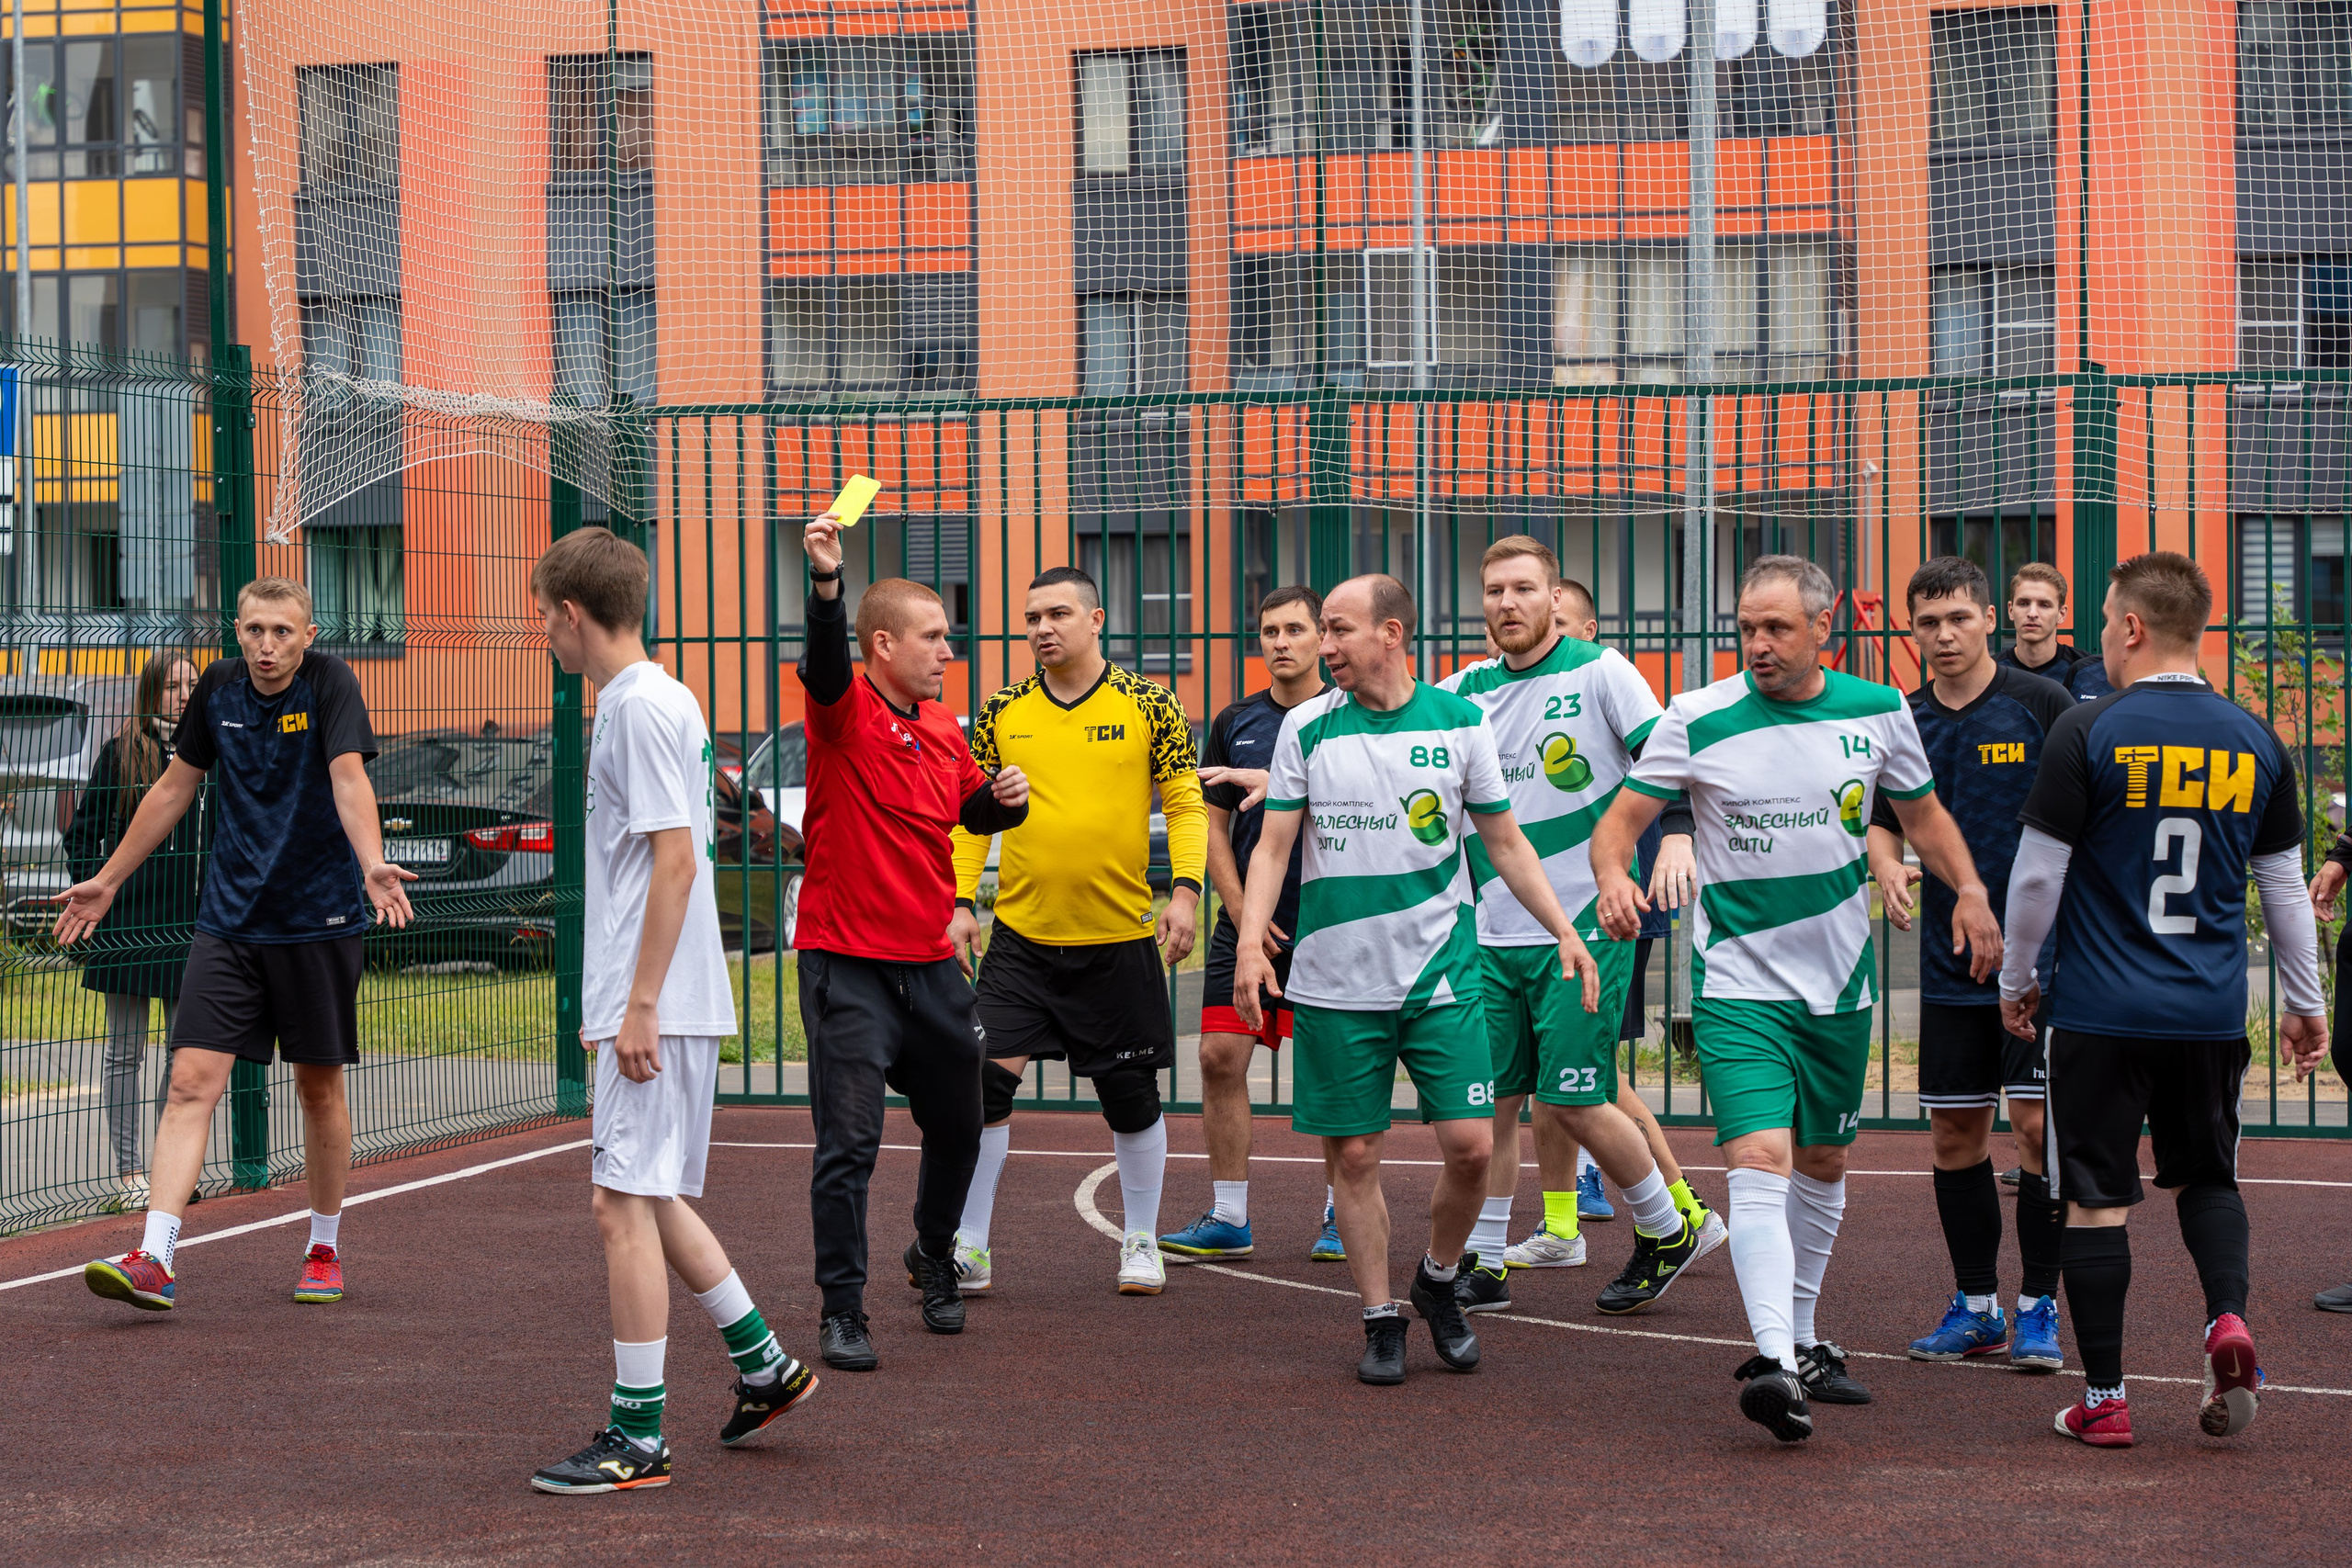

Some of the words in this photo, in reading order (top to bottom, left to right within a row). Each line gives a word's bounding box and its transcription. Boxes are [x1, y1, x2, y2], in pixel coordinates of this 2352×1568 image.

[1544, 693, 1581, 720] 23
[1084, 724, 1125, 743] ТСИ
[1409, 745, 1450, 769] 88
[1838, 735, 1871, 759] 14
[1977, 742, 2025, 764] ТСИ
[2115, 744, 2256, 814] ТСИ
[1332, 800, 1374, 808] КОМПЛЕКС
[1721, 798, 1750, 807] ЖИЛОЙ
[1752, 796, 1802, 807] КОМПЛЕКС
[1724, 807, 1829, 830] ЗАЛЕСНЫЙ
[1728, 837, 1773, 853] СИТИ
[2147, 817, 2202, 934] 2
[1116, 1046, 1154, 1059] KELME
[1558, 1067, 1597, 1092] 23
[1467, 1080, 1494, 1106] 88
[1838, 1111, 1859, 1134] 14
